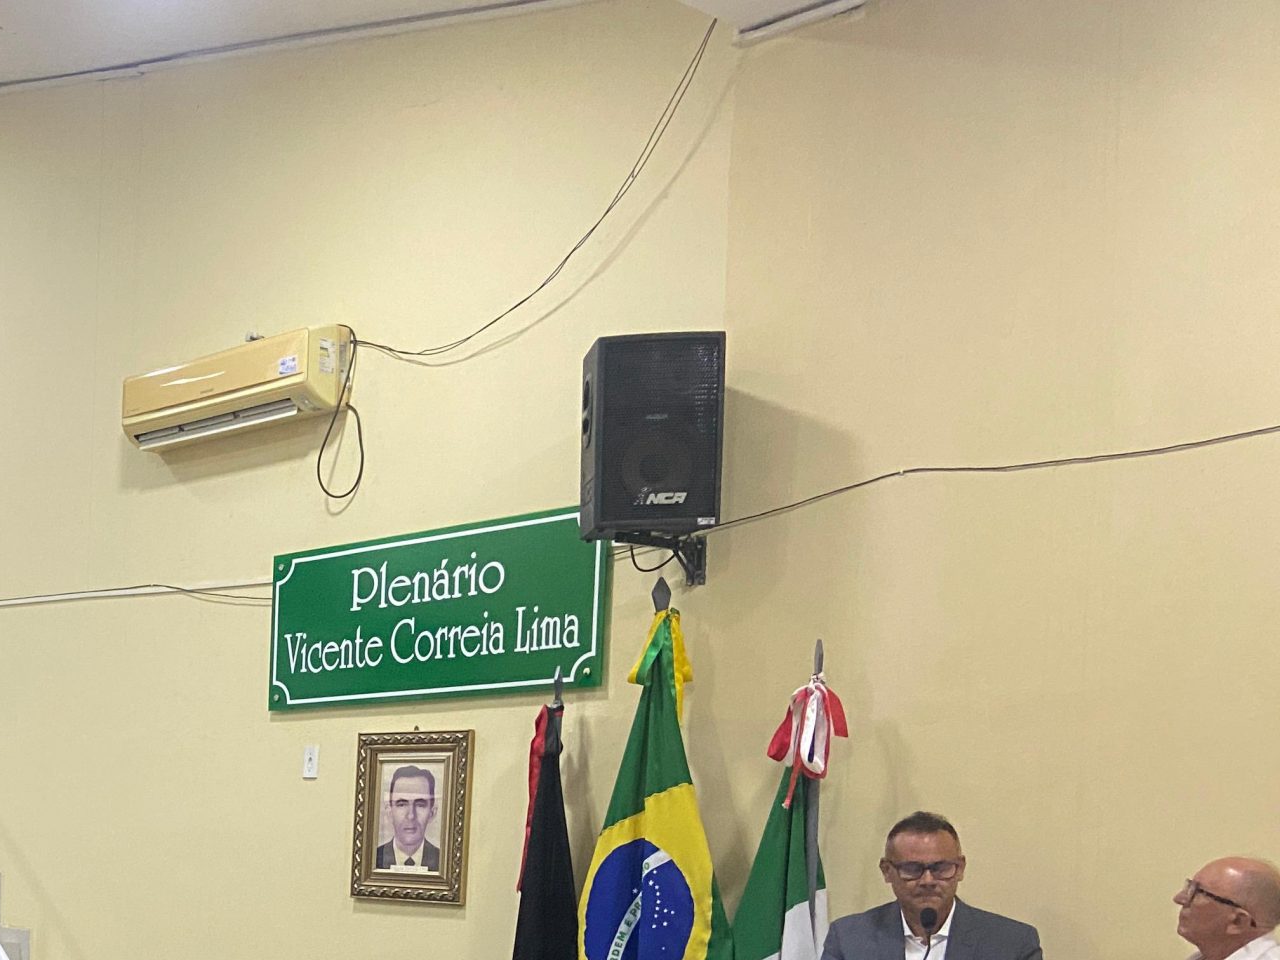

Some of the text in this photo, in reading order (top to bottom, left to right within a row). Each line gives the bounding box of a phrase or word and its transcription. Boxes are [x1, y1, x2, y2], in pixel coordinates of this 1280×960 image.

[349, 551, 505, 611] Plenário
[284, 605, 580, 674] Vicente Correia Lima
[625, 918, 633, 928] E
